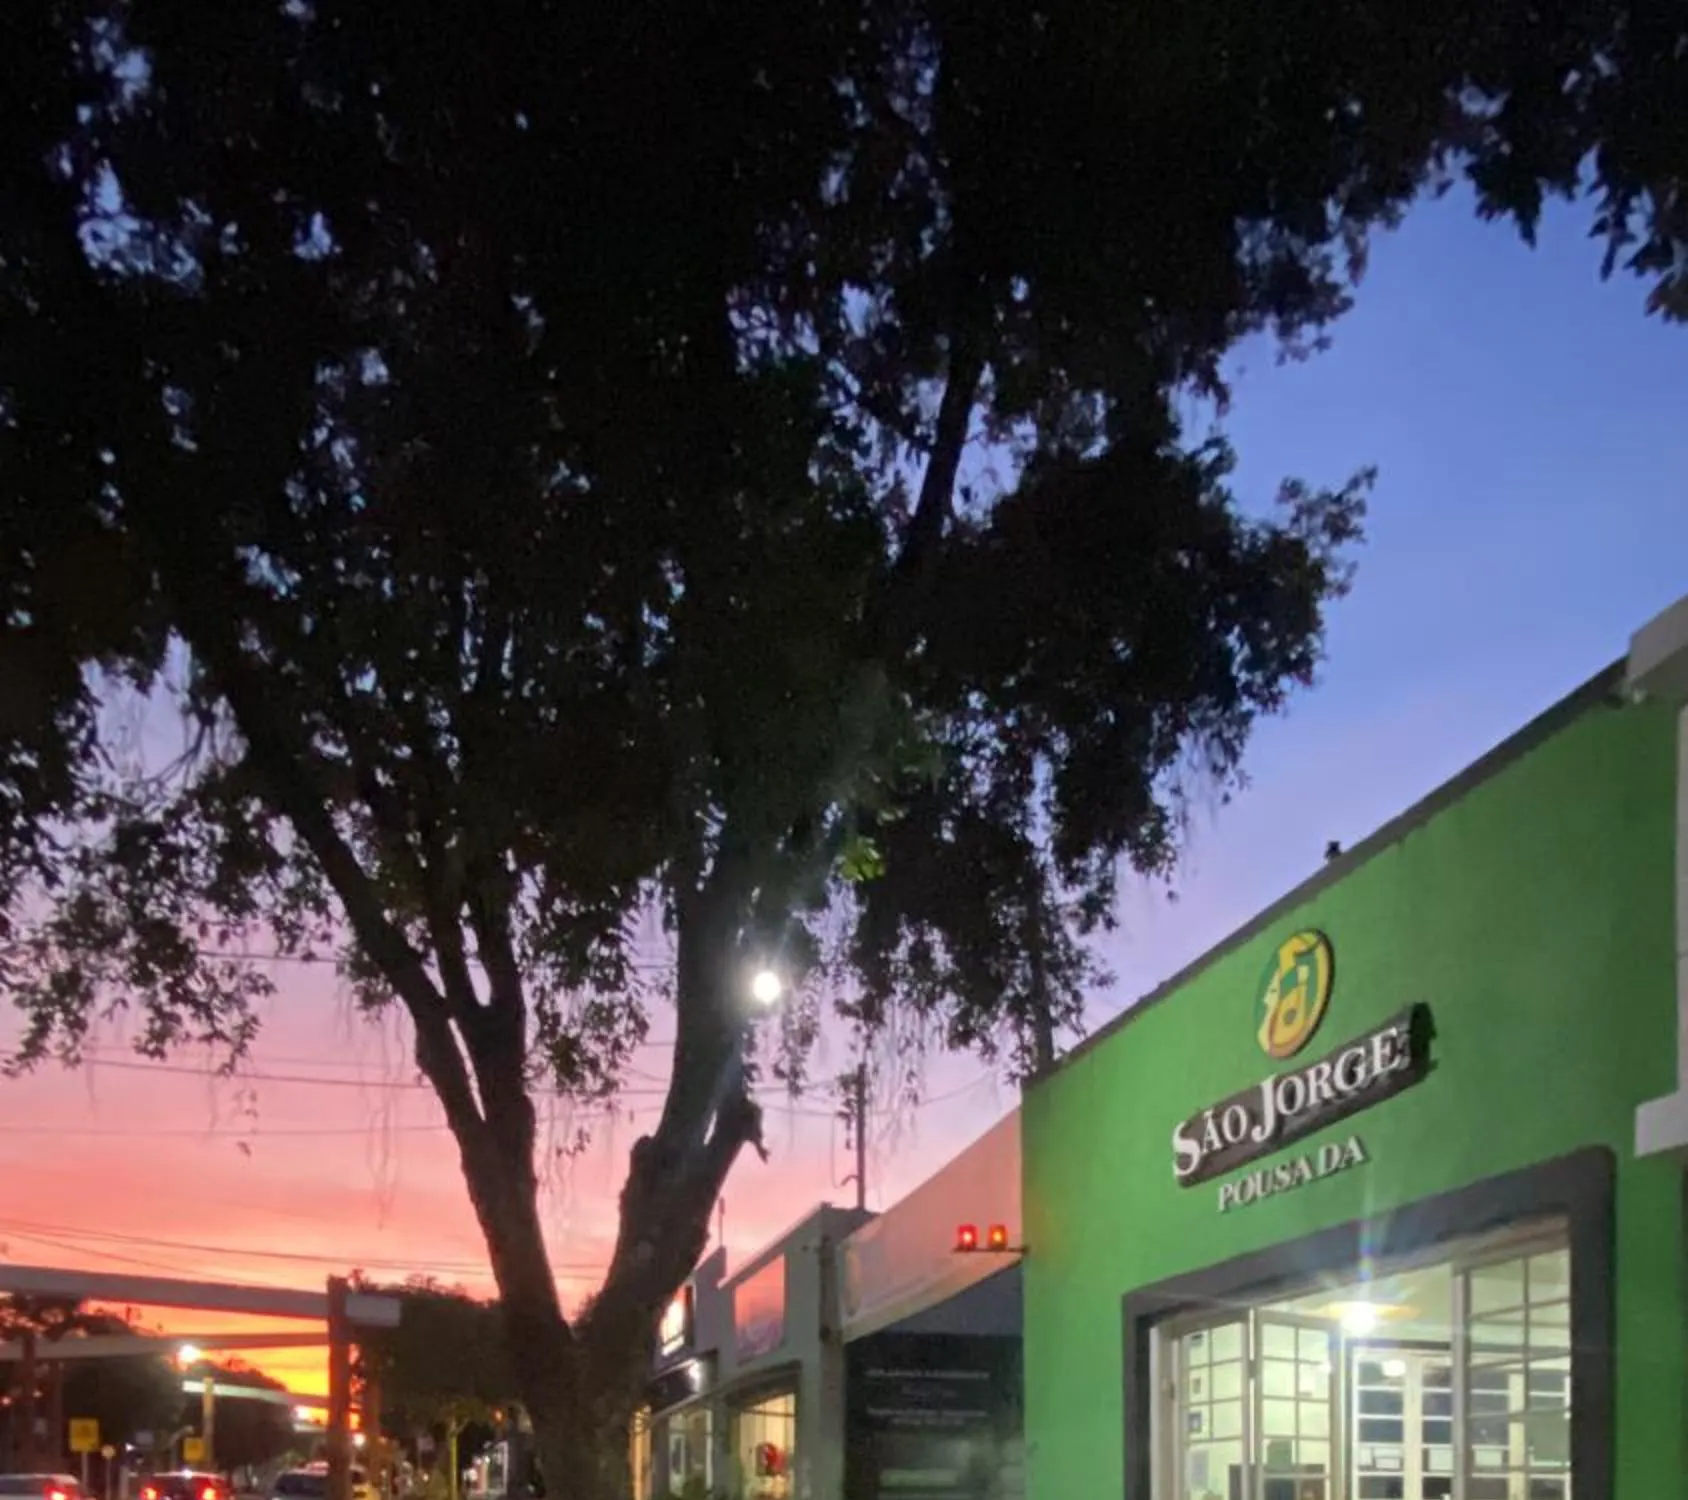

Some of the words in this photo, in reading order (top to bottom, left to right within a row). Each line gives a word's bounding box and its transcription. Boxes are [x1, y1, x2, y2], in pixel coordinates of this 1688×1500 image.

[1172, 1104, 1249, 1178] SÃO
[1251, 1026, 1402, 1143] JORGE
[1217, 1135, 1366, 1213] POUSADA
